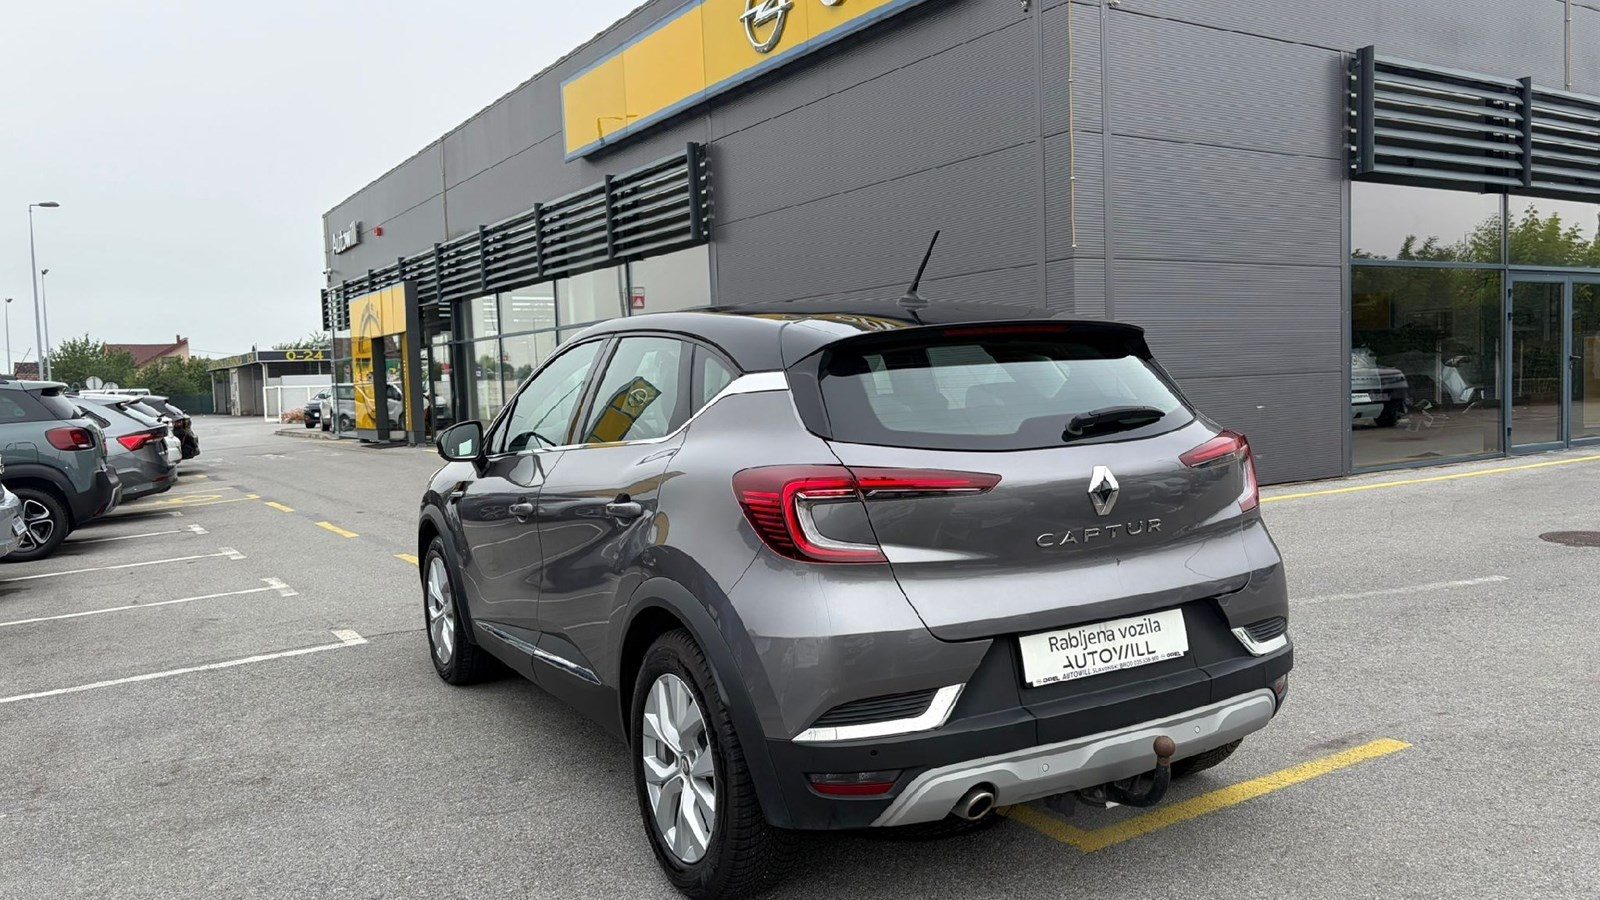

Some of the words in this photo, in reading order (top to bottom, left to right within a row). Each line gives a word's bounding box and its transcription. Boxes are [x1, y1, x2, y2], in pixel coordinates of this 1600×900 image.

[1036, 518, 1162, 548] CAPTUR
[1048, 629, 1116, 652] Rabljena
[1118, 618, 1161, 639] vozila
[1062, 669, 1091, 680] AUTOWILL
